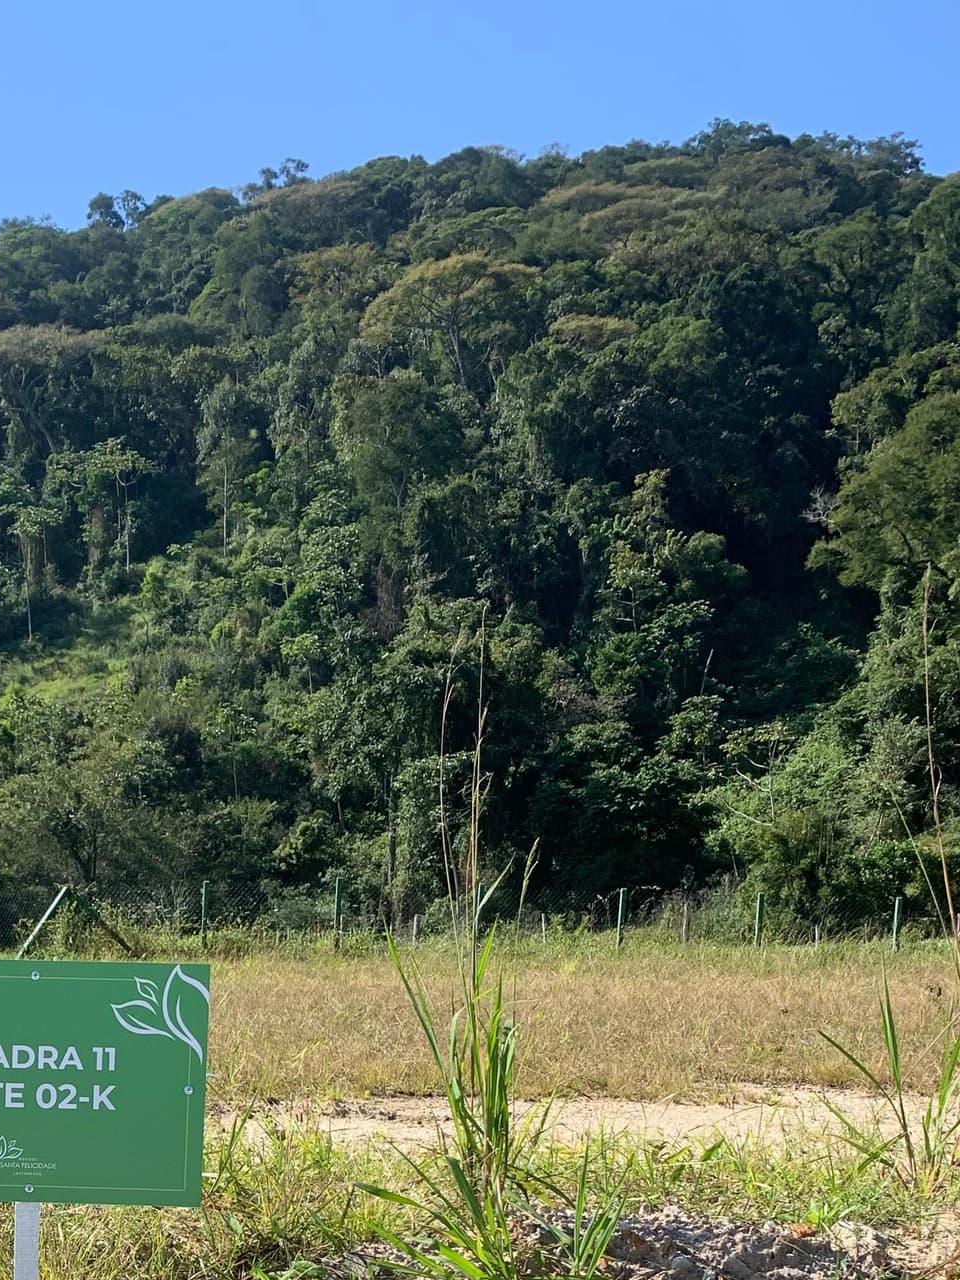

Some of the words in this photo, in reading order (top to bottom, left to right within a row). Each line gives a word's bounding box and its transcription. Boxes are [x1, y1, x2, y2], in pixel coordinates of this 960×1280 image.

[92, 1047, 116, 1071] 11
[35, 1083, 116, 1110] 02-K
[21, 1162, 57, 1170] FELICIDADE
